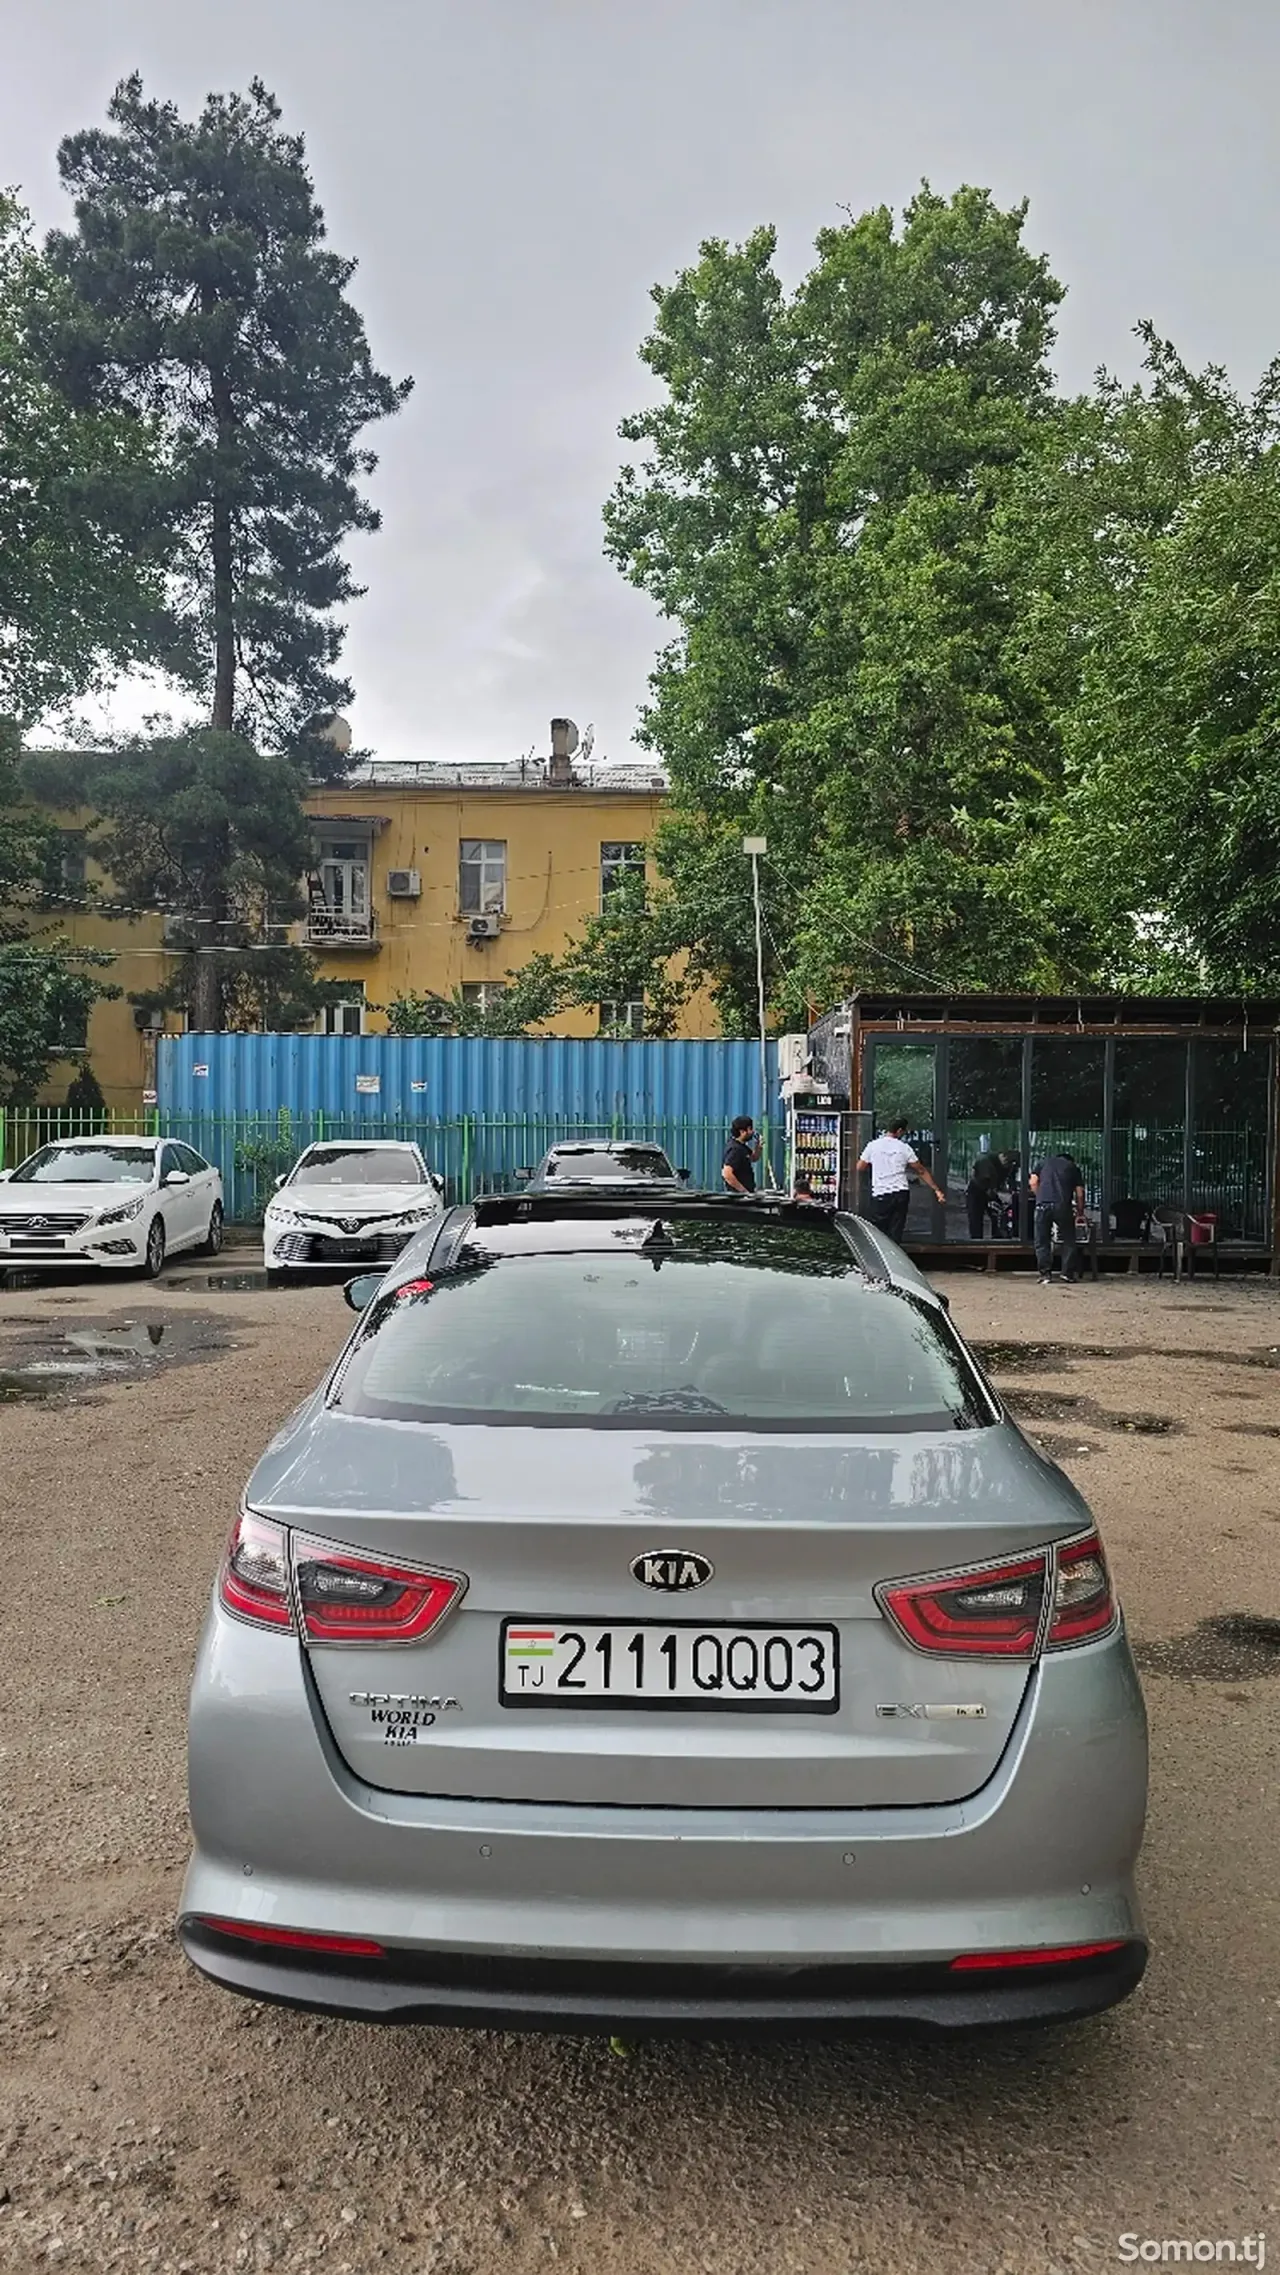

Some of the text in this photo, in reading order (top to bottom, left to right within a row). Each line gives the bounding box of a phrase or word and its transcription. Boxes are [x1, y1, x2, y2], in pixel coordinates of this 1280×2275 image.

[643, 1559, 701, 1584] KIA
[557, 1632, 826, 1692] 2111QQ03
[517, 1664, 545, 1688] TJ
[349, 1691, 463, 1711] OPTIMA
[371, 1710, 436, 1726] WORLD
[385, 1725, 418, 1740] KIA
